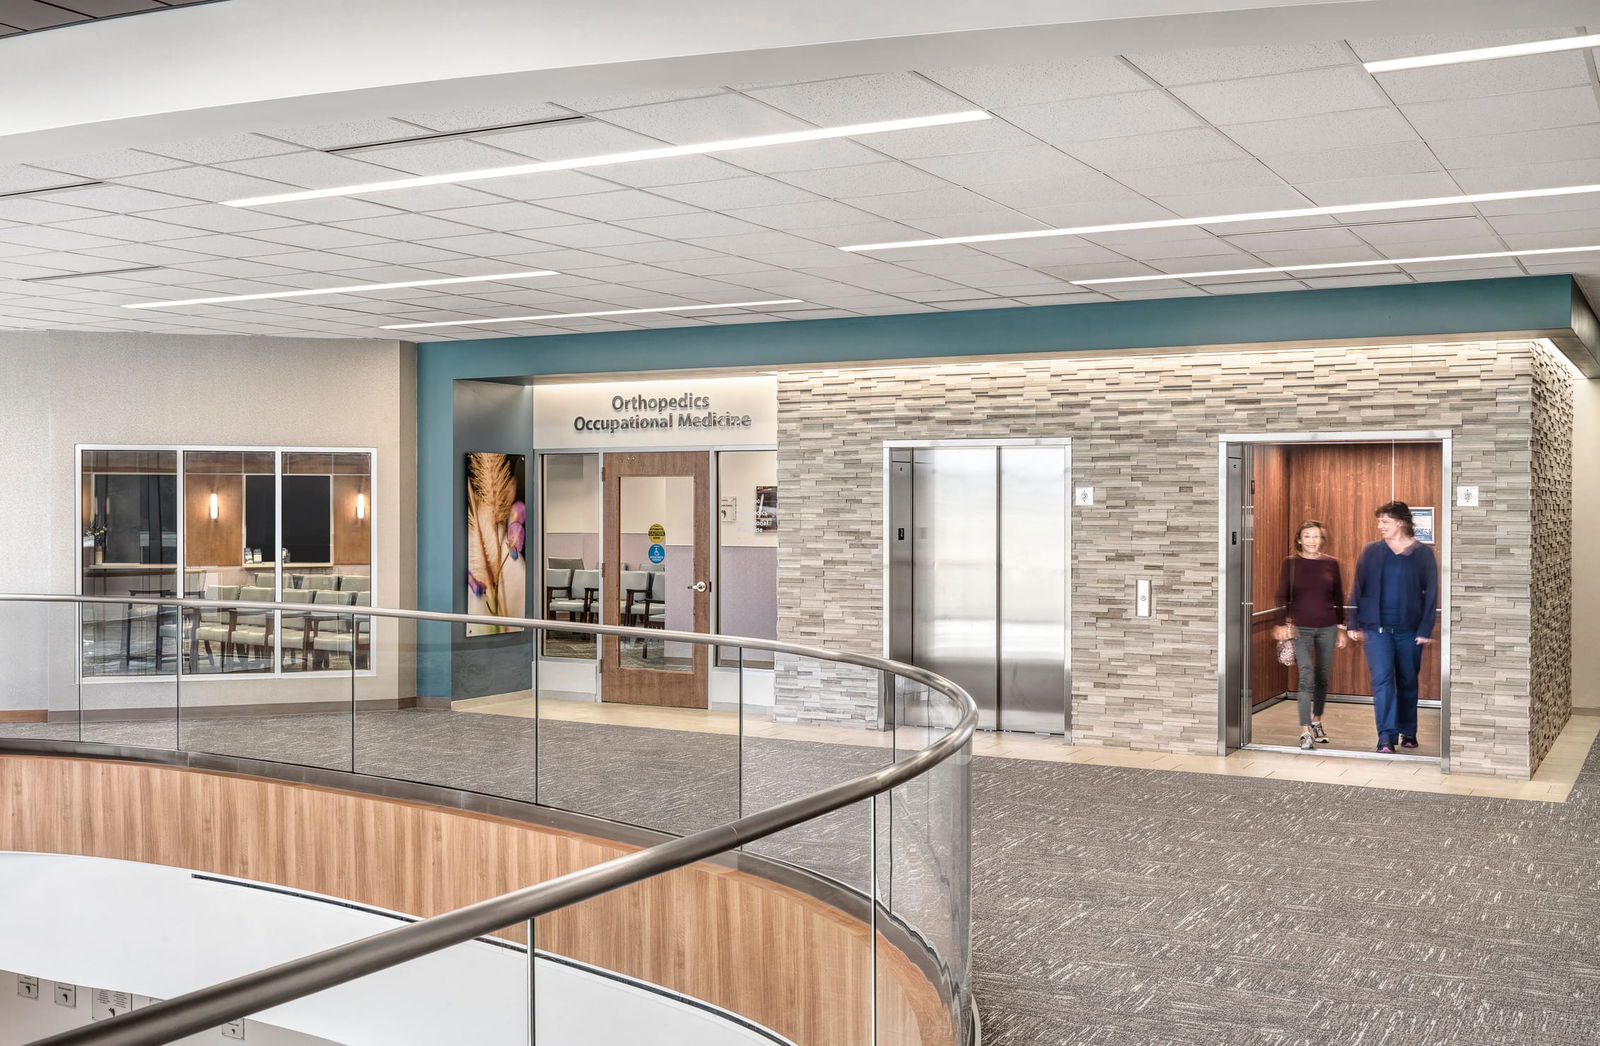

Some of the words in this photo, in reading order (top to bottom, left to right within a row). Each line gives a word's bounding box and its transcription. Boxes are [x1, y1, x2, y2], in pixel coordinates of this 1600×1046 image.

[611, 393, 710, 412] Orthopedics
[573, 413, 673, 433] Occupational
[677, 411, 752, 428] Medicine
